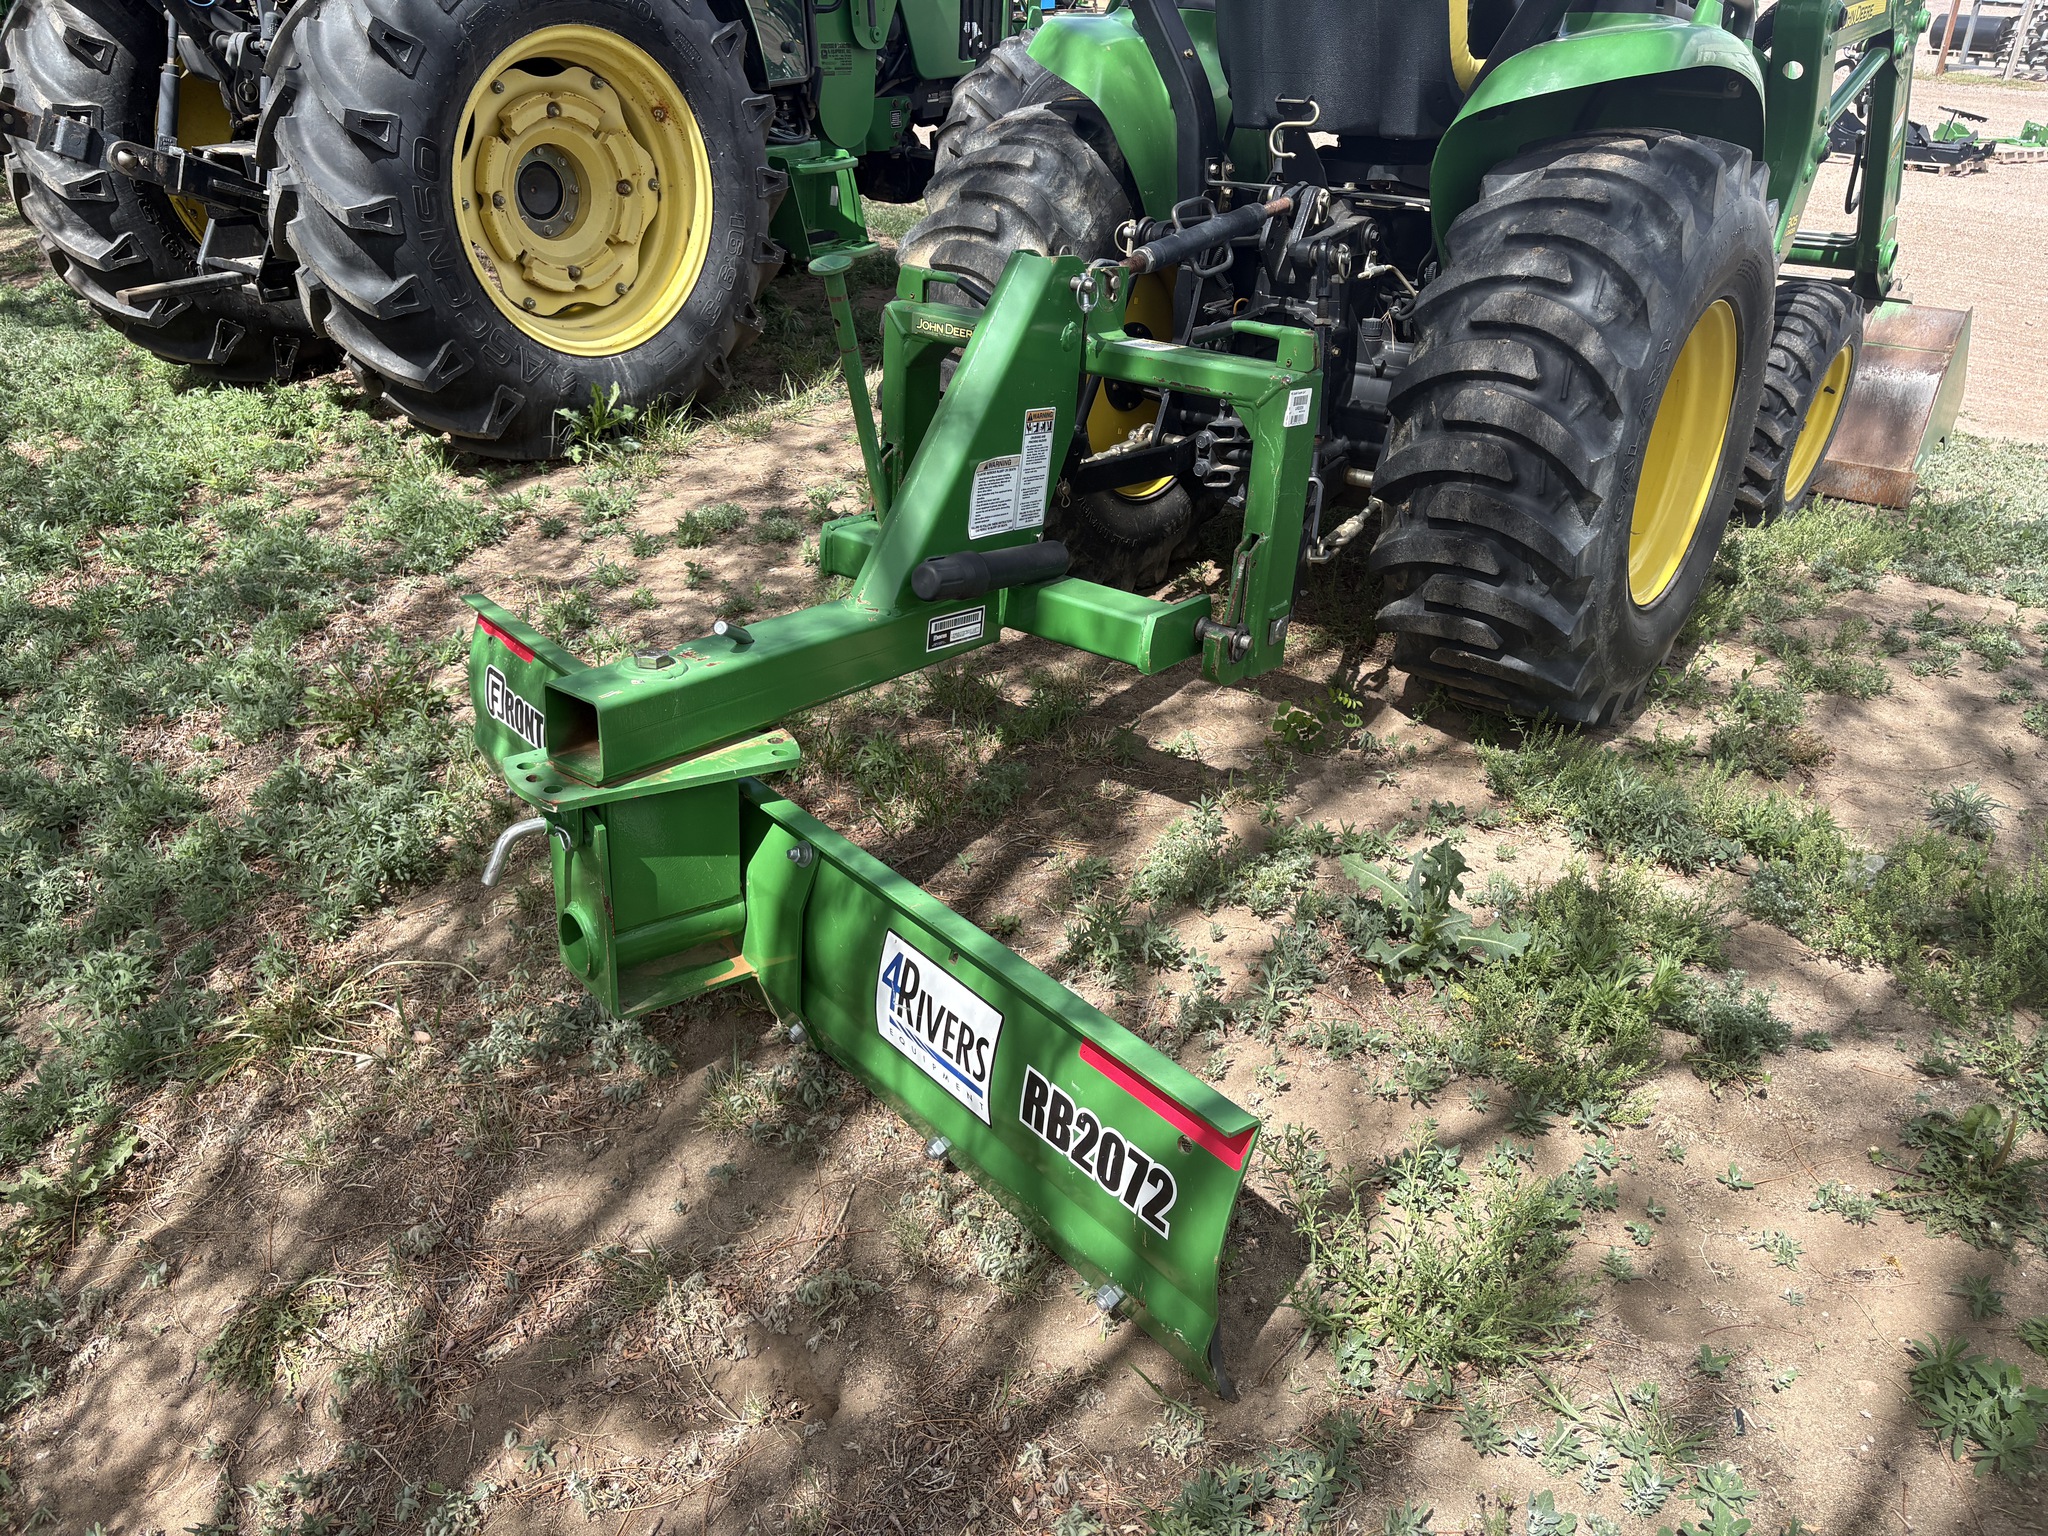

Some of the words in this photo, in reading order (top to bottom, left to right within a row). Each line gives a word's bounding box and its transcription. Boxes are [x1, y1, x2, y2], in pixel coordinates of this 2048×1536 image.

[412, 137, 550, 383] ASCENSO
[916, 318, 944, 334] JOHN
[945, 323, 973, 338] DEER
[1032, 411, 1054, 420] WARNING
[988, 459, 1012, 469] WARNING
[486, 666, 546, 749] FRONT
[889, 1028, 984, 1111] EQUIPMENT
[1022, 1068, 1176, 1236] RB2072
